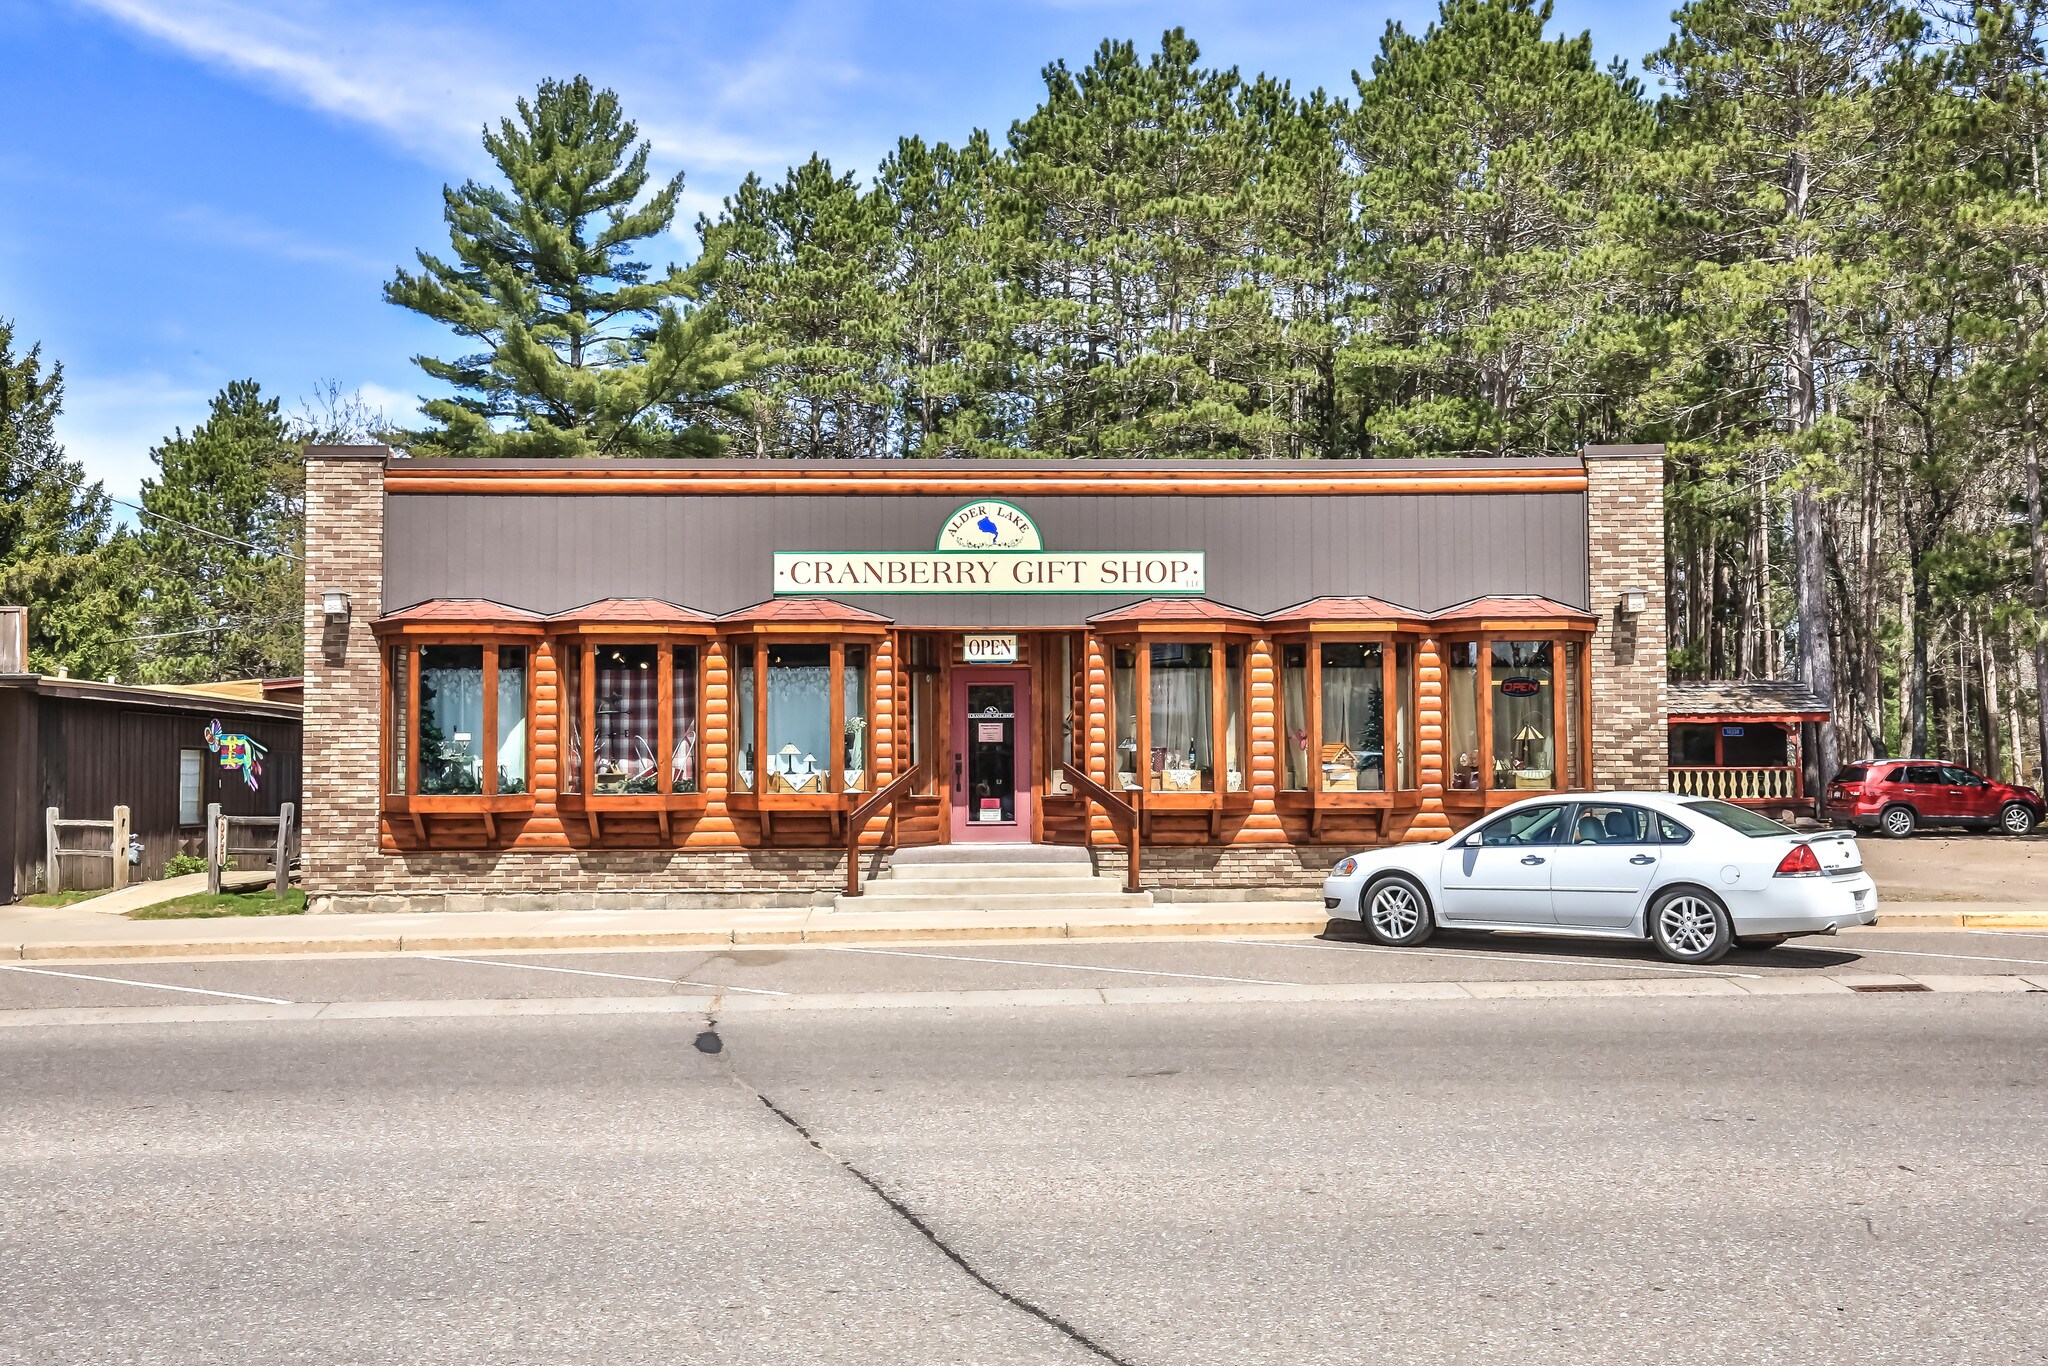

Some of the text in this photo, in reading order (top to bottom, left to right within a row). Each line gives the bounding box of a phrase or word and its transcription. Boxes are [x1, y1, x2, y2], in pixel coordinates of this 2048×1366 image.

[947, 505, 1030, 537] ALDER LAKE
[790, 560, 1189, 584] CRANBERRY GIFT SHOP
[968, 639, 1011, 656] OPEN
[1503, 682, 1539, 692] OPEN
